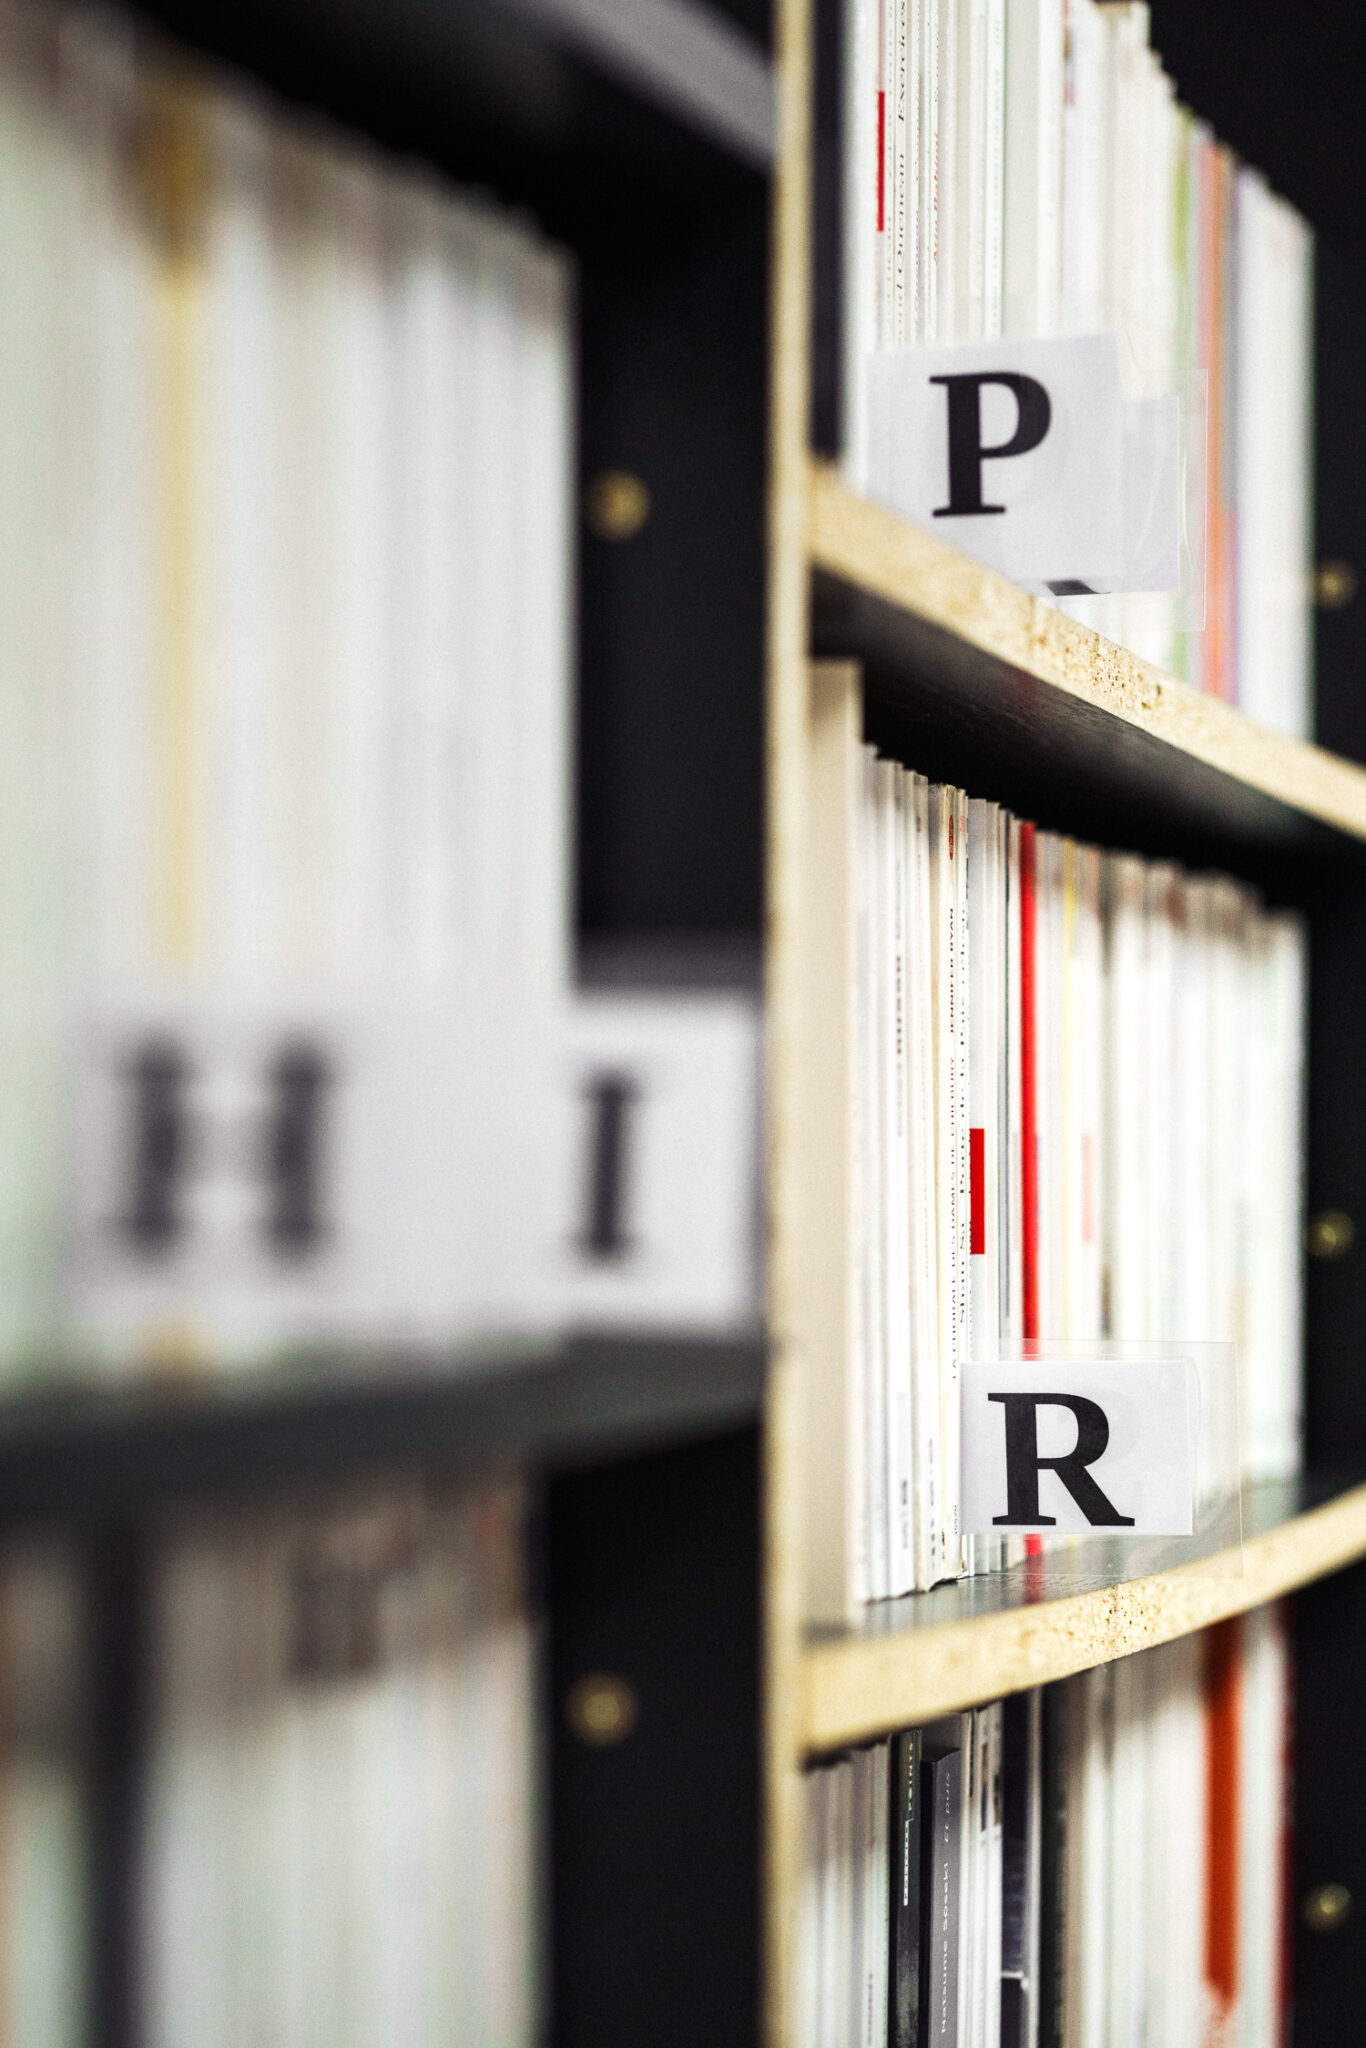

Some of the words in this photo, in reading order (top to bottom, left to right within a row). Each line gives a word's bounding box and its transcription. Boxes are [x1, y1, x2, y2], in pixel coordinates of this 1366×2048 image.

[929, 371, 1052, 518] P
[112, 1035, 336, 1264] H
[575, 1068, 642, 1262] I
[988, 1393, 1135, 1526] R
[940, 1939, 948, 2034] Natsume
